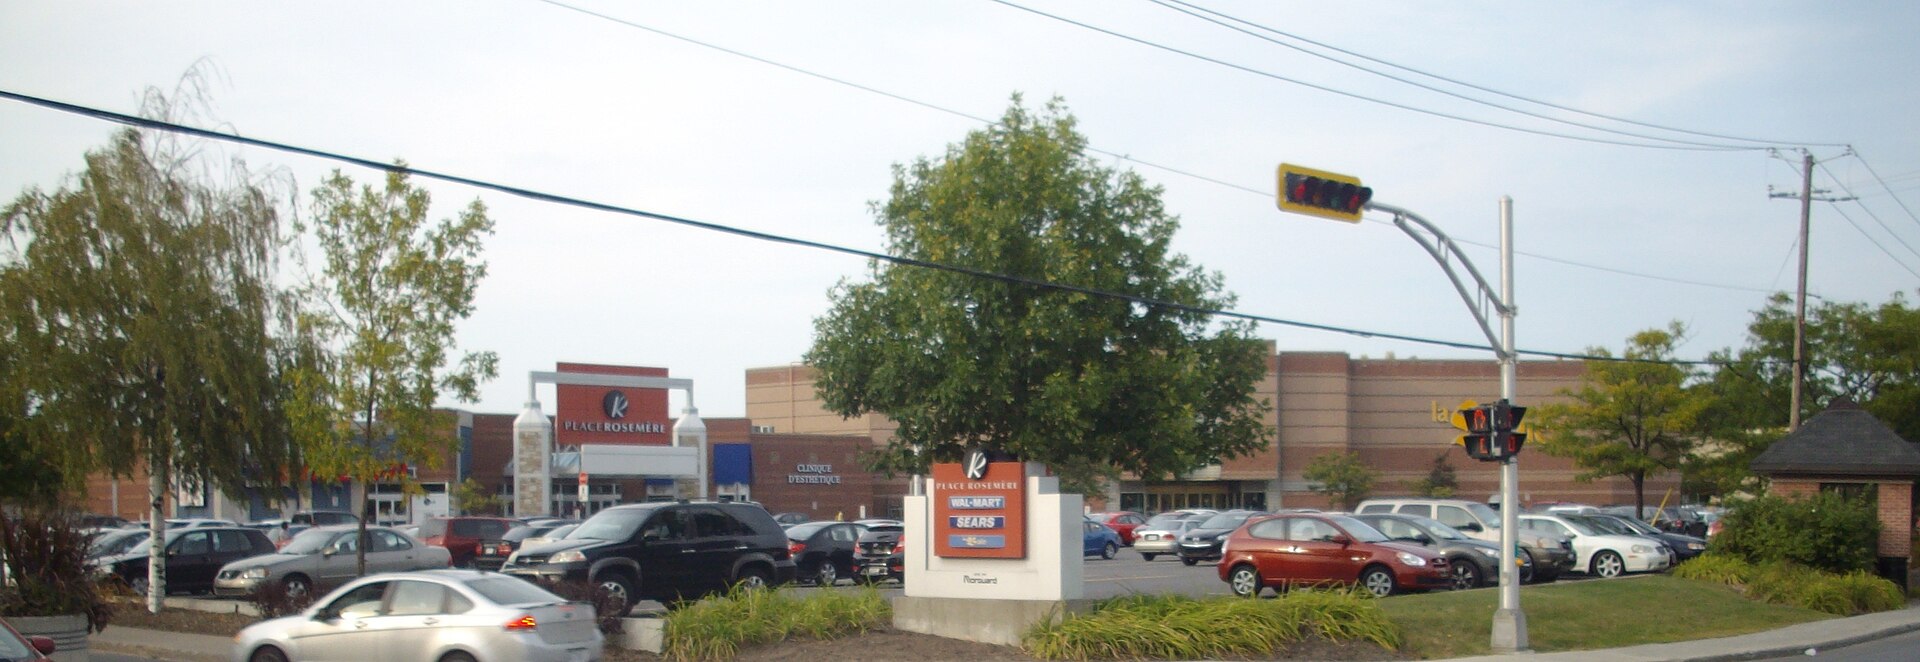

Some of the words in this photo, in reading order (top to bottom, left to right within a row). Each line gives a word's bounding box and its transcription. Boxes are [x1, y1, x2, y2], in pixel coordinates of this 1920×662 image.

[797, 464, 832, 473] CLINIQUE
[936, 482, 964, 490] PLACE
[951, 498, 1001, 508] WAL-MART
[956, 517, 996, 528] SEARS
